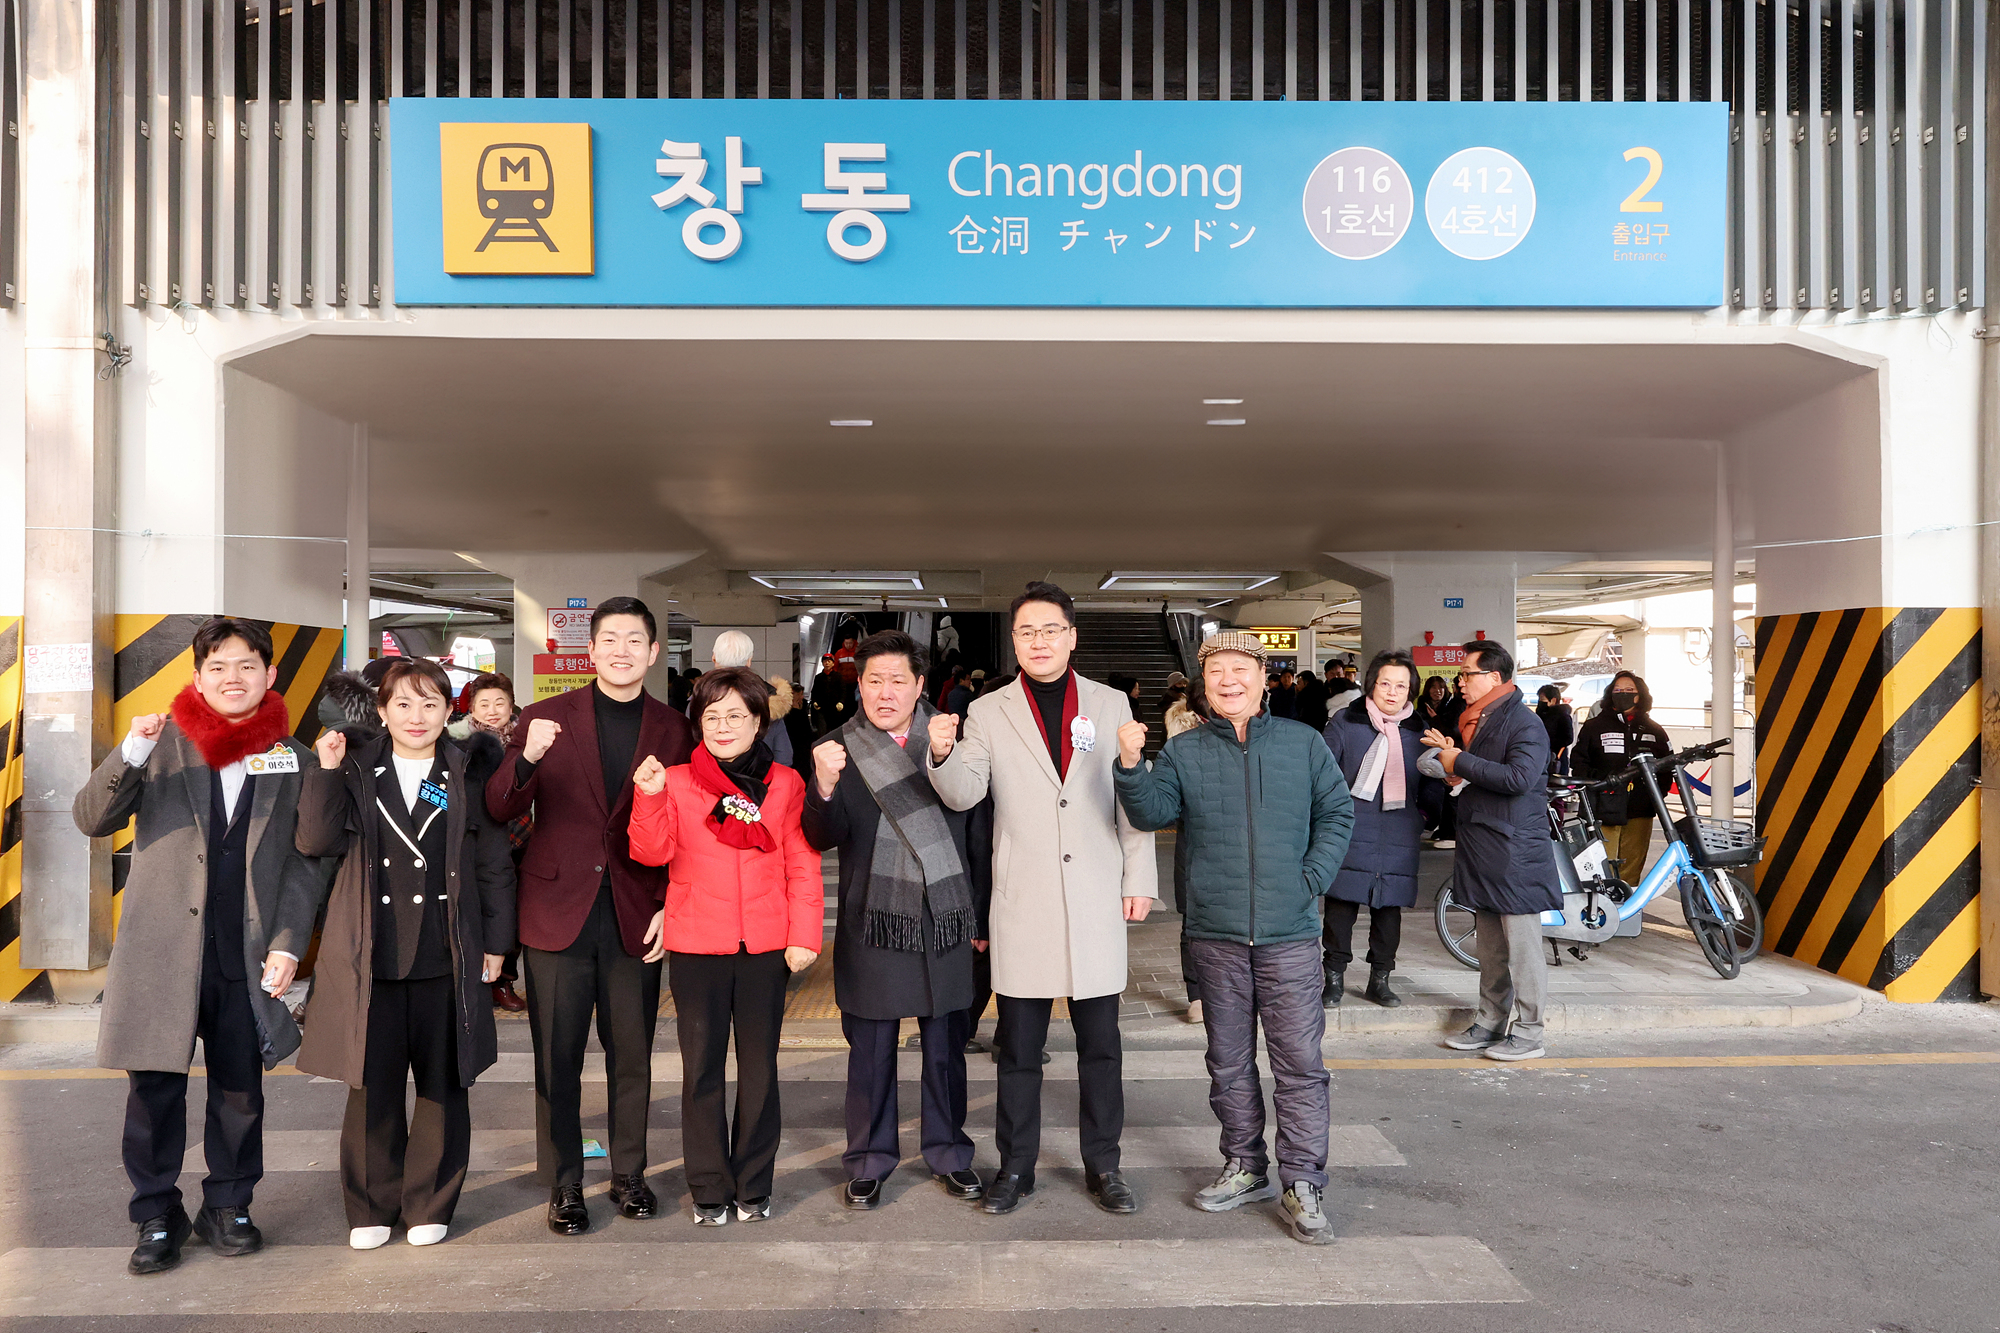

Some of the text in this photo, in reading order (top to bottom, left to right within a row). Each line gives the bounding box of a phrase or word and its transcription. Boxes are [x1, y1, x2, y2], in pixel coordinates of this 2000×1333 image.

[948, 149, 1243, 211] Changdong
[1332, 165, 1391, 194] 116
[1453, 165, 1513, 194] 412
[1619, 146, 1664, 213] 2
[948, 214, 1029, 256] 仓洞
[1321, 203, 1396, 238] 1호선
[1441, 203, 1518, 238] 4호선
[1610, 221, 1672, 246] 출입구
[1613, 249, 1668, 262] Entrance
[569, 613, 592, 623] 금연구
[1433, 650, 1467, 663] 통행안
[268, 760, 294, 769] 이호석
[730, 795, 759, 815] 시의원
